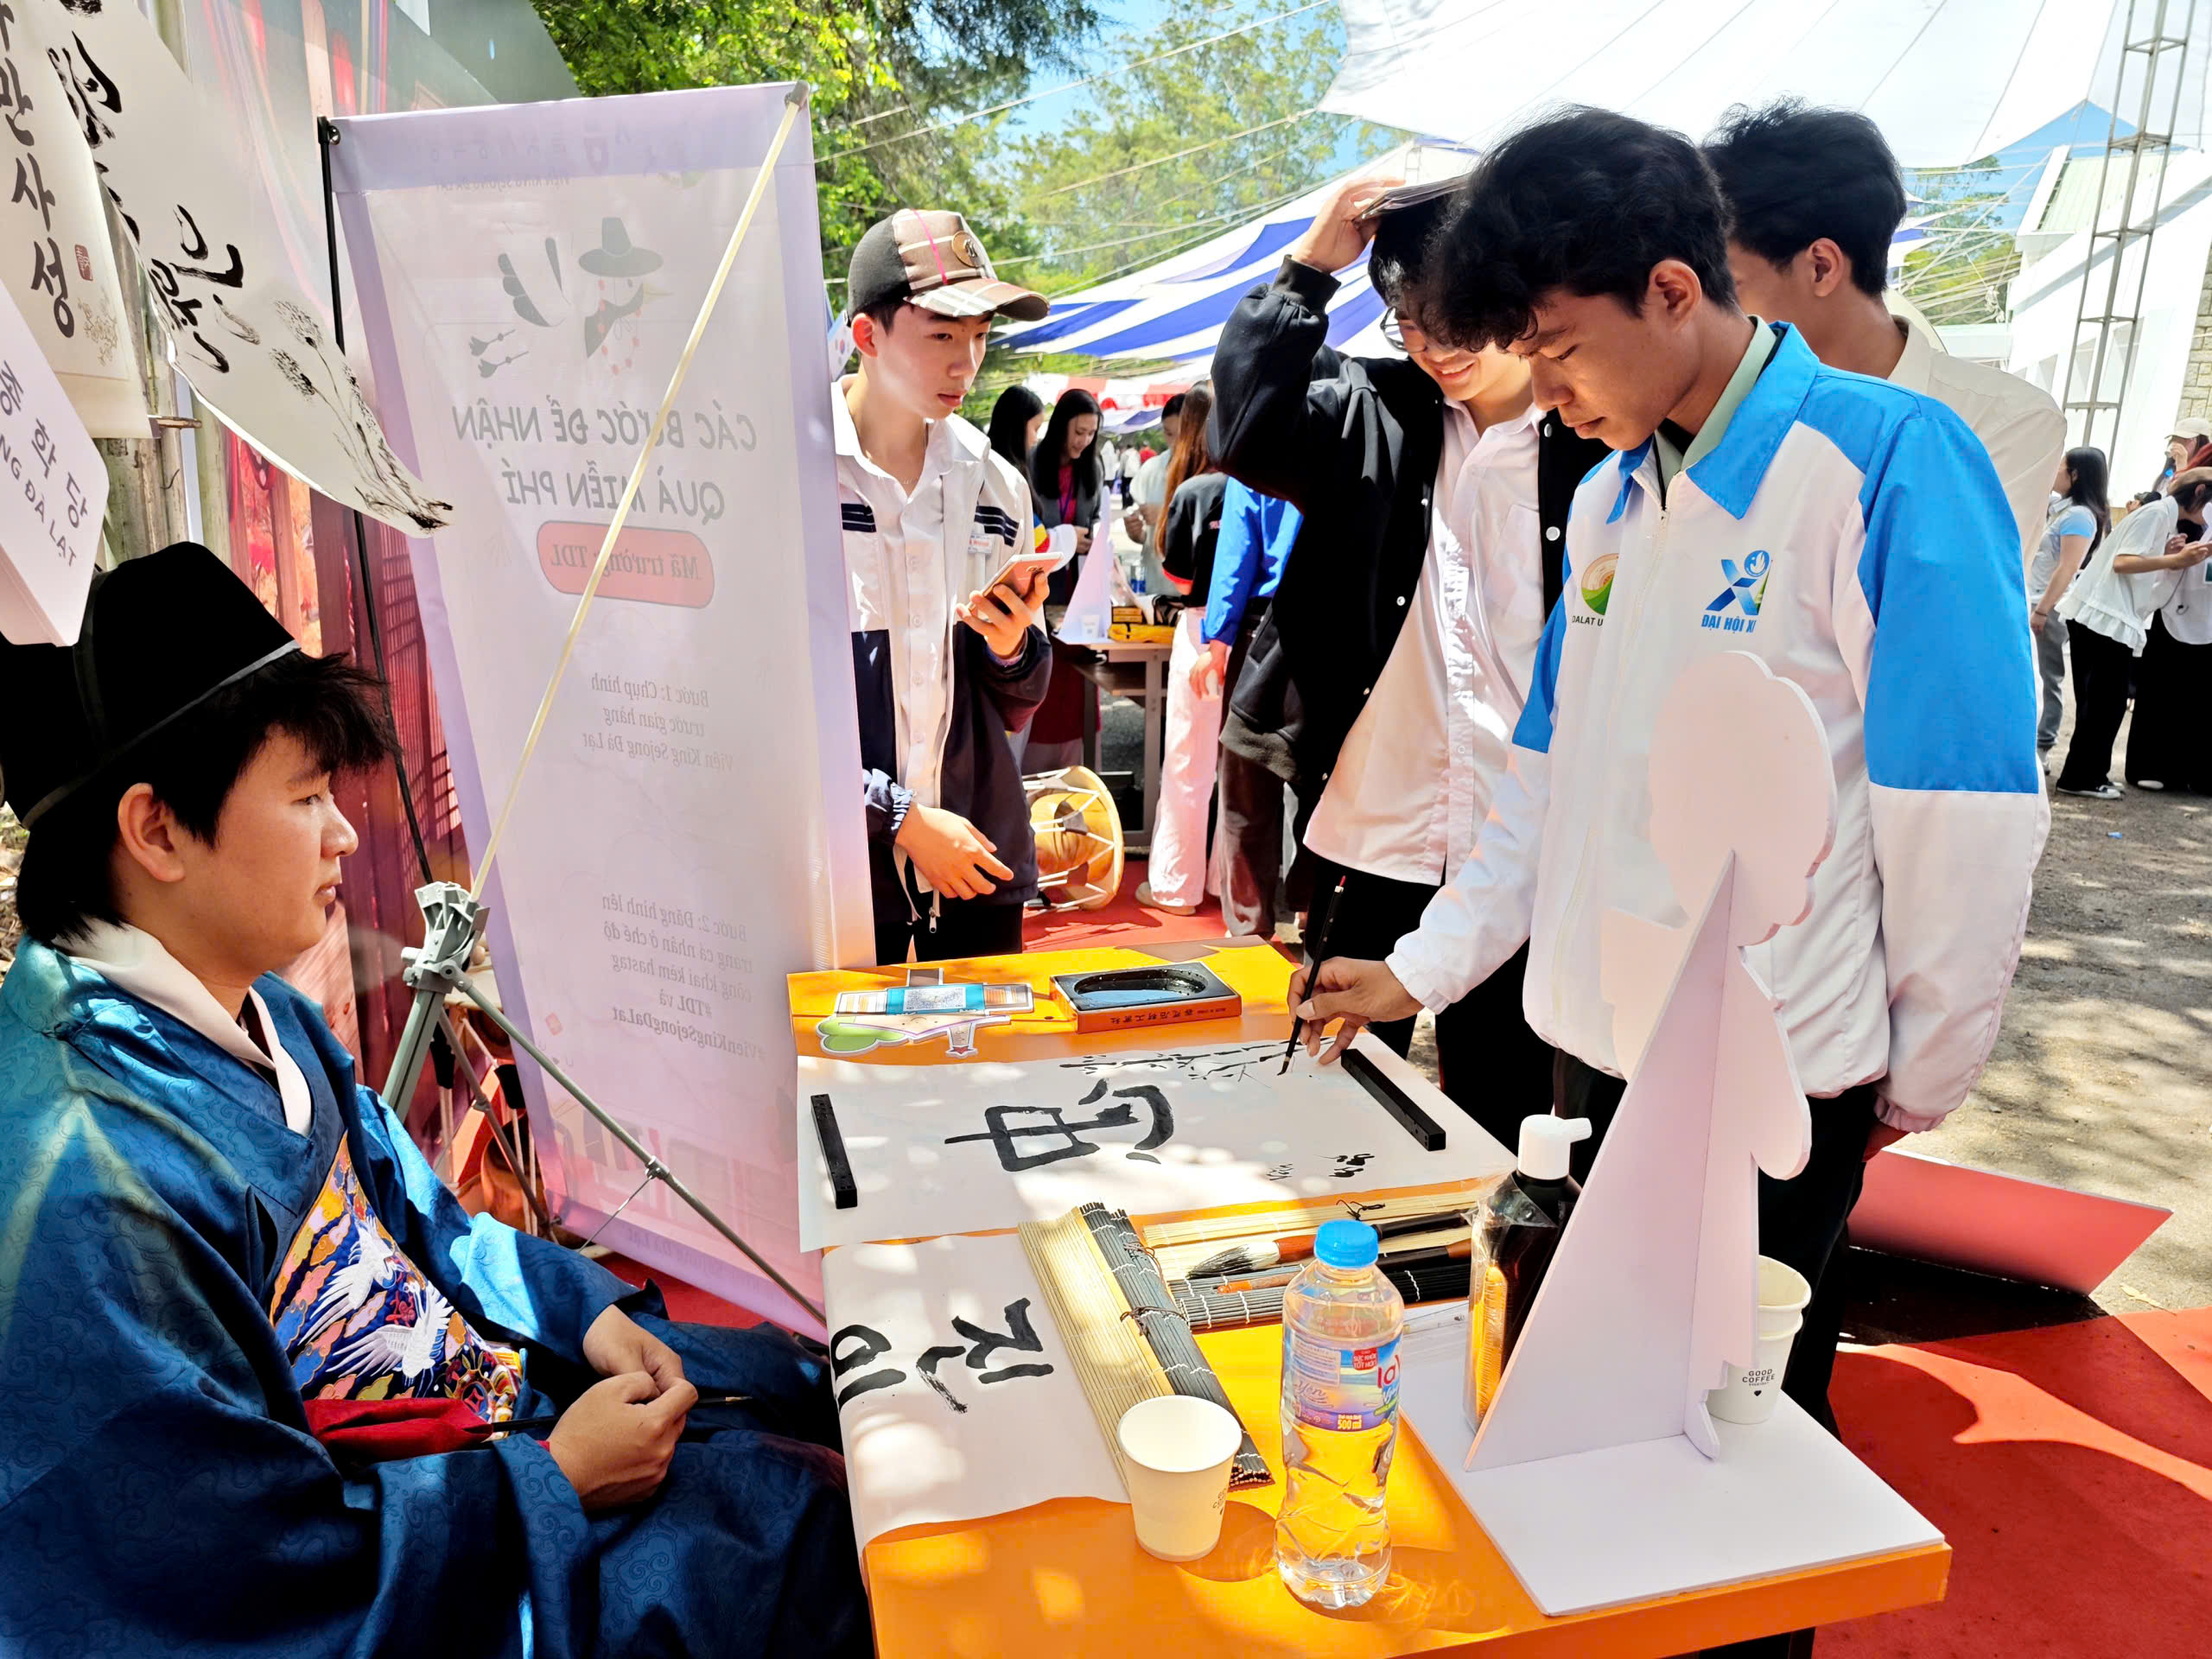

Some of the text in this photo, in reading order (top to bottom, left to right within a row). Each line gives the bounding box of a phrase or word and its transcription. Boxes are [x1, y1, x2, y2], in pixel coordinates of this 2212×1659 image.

[24, 477, 44, 524] ĐÀ
[49, 518, 77, 567] LẠT
[1701, 614, 1721, 631] ĐẠI
[1724, 615, 1745, 633] HỘI
[1742, 1374, 1775, 1383] COFFEE
[1338, 1419, 1351, 1429] 500
